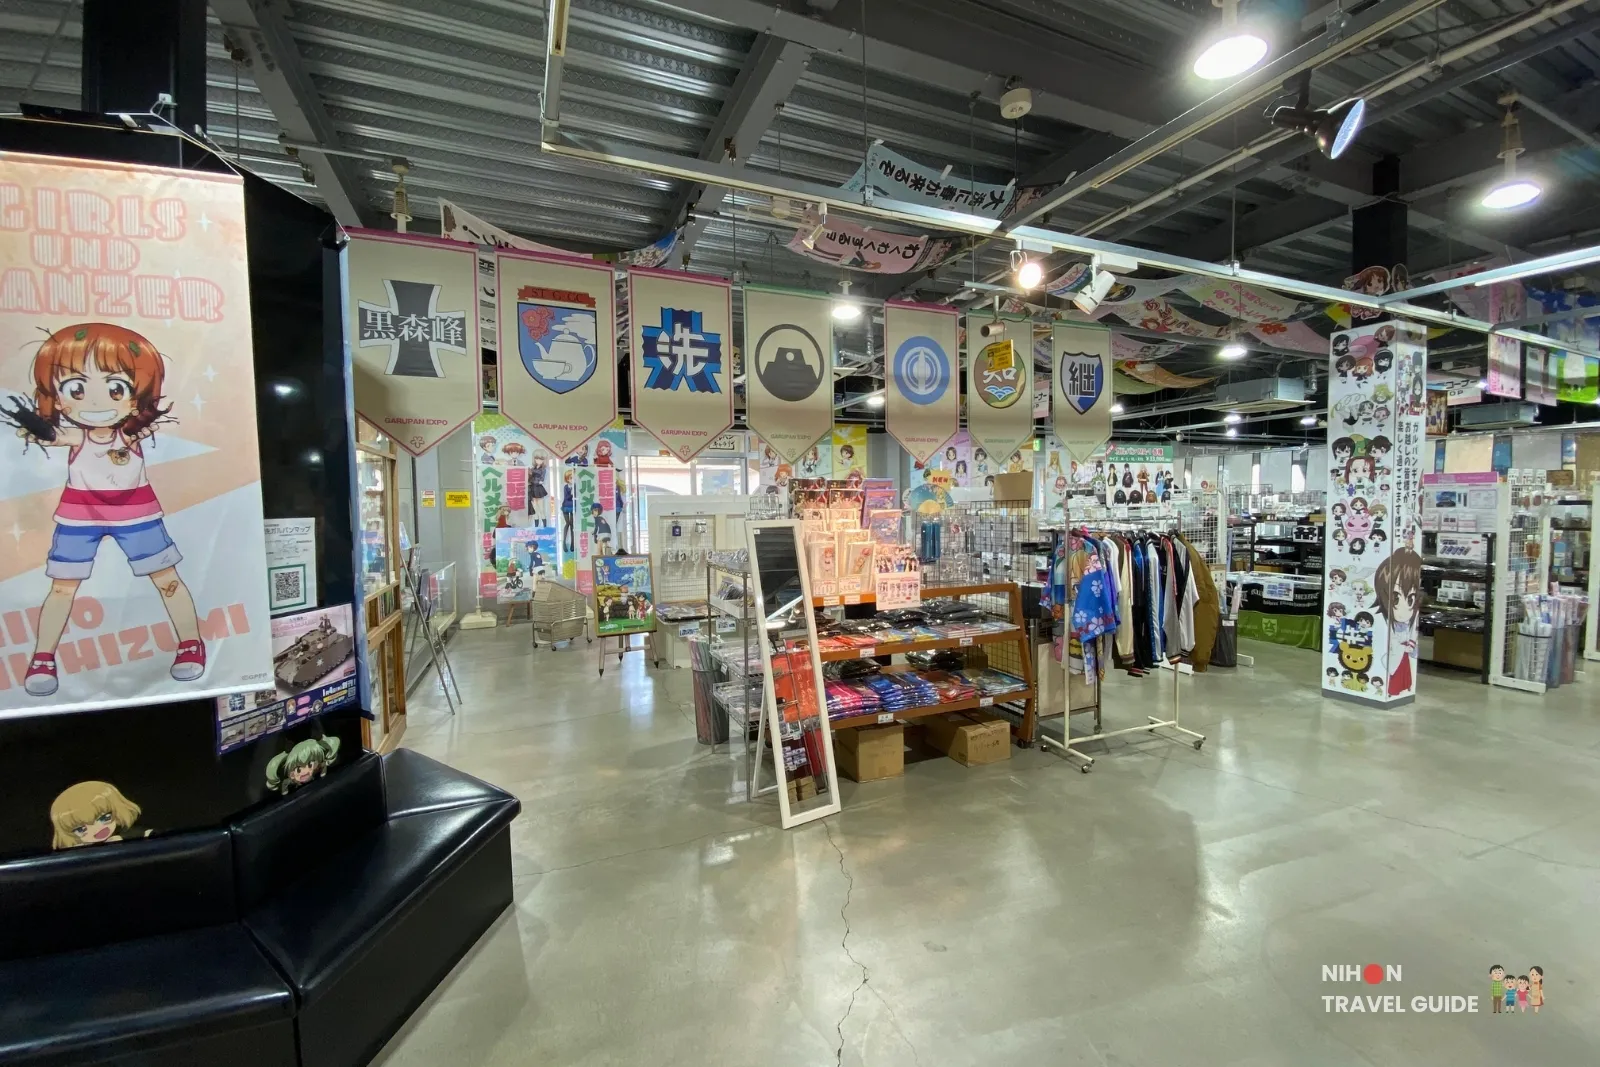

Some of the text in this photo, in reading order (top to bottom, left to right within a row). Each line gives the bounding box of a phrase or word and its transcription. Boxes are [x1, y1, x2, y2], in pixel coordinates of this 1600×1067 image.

[0, 181, 187, 242] GIRLS
[30, 231, 141, 274] UND
[363, 309, 464, 345] 黒森峰
[656, 322, 709, 377] 洗
[1068, 361, 1096, 397] 継
[384, 416, 448, 427] GARUPAN EXPO
[532, 422, 588, 432] GARUPAN EXPO
[660, 428, 708, 437] GARUPAN EXPO
[482, 466, 503, 532] ヘルメット
[578, 469, 595, 532] ヘルメット
